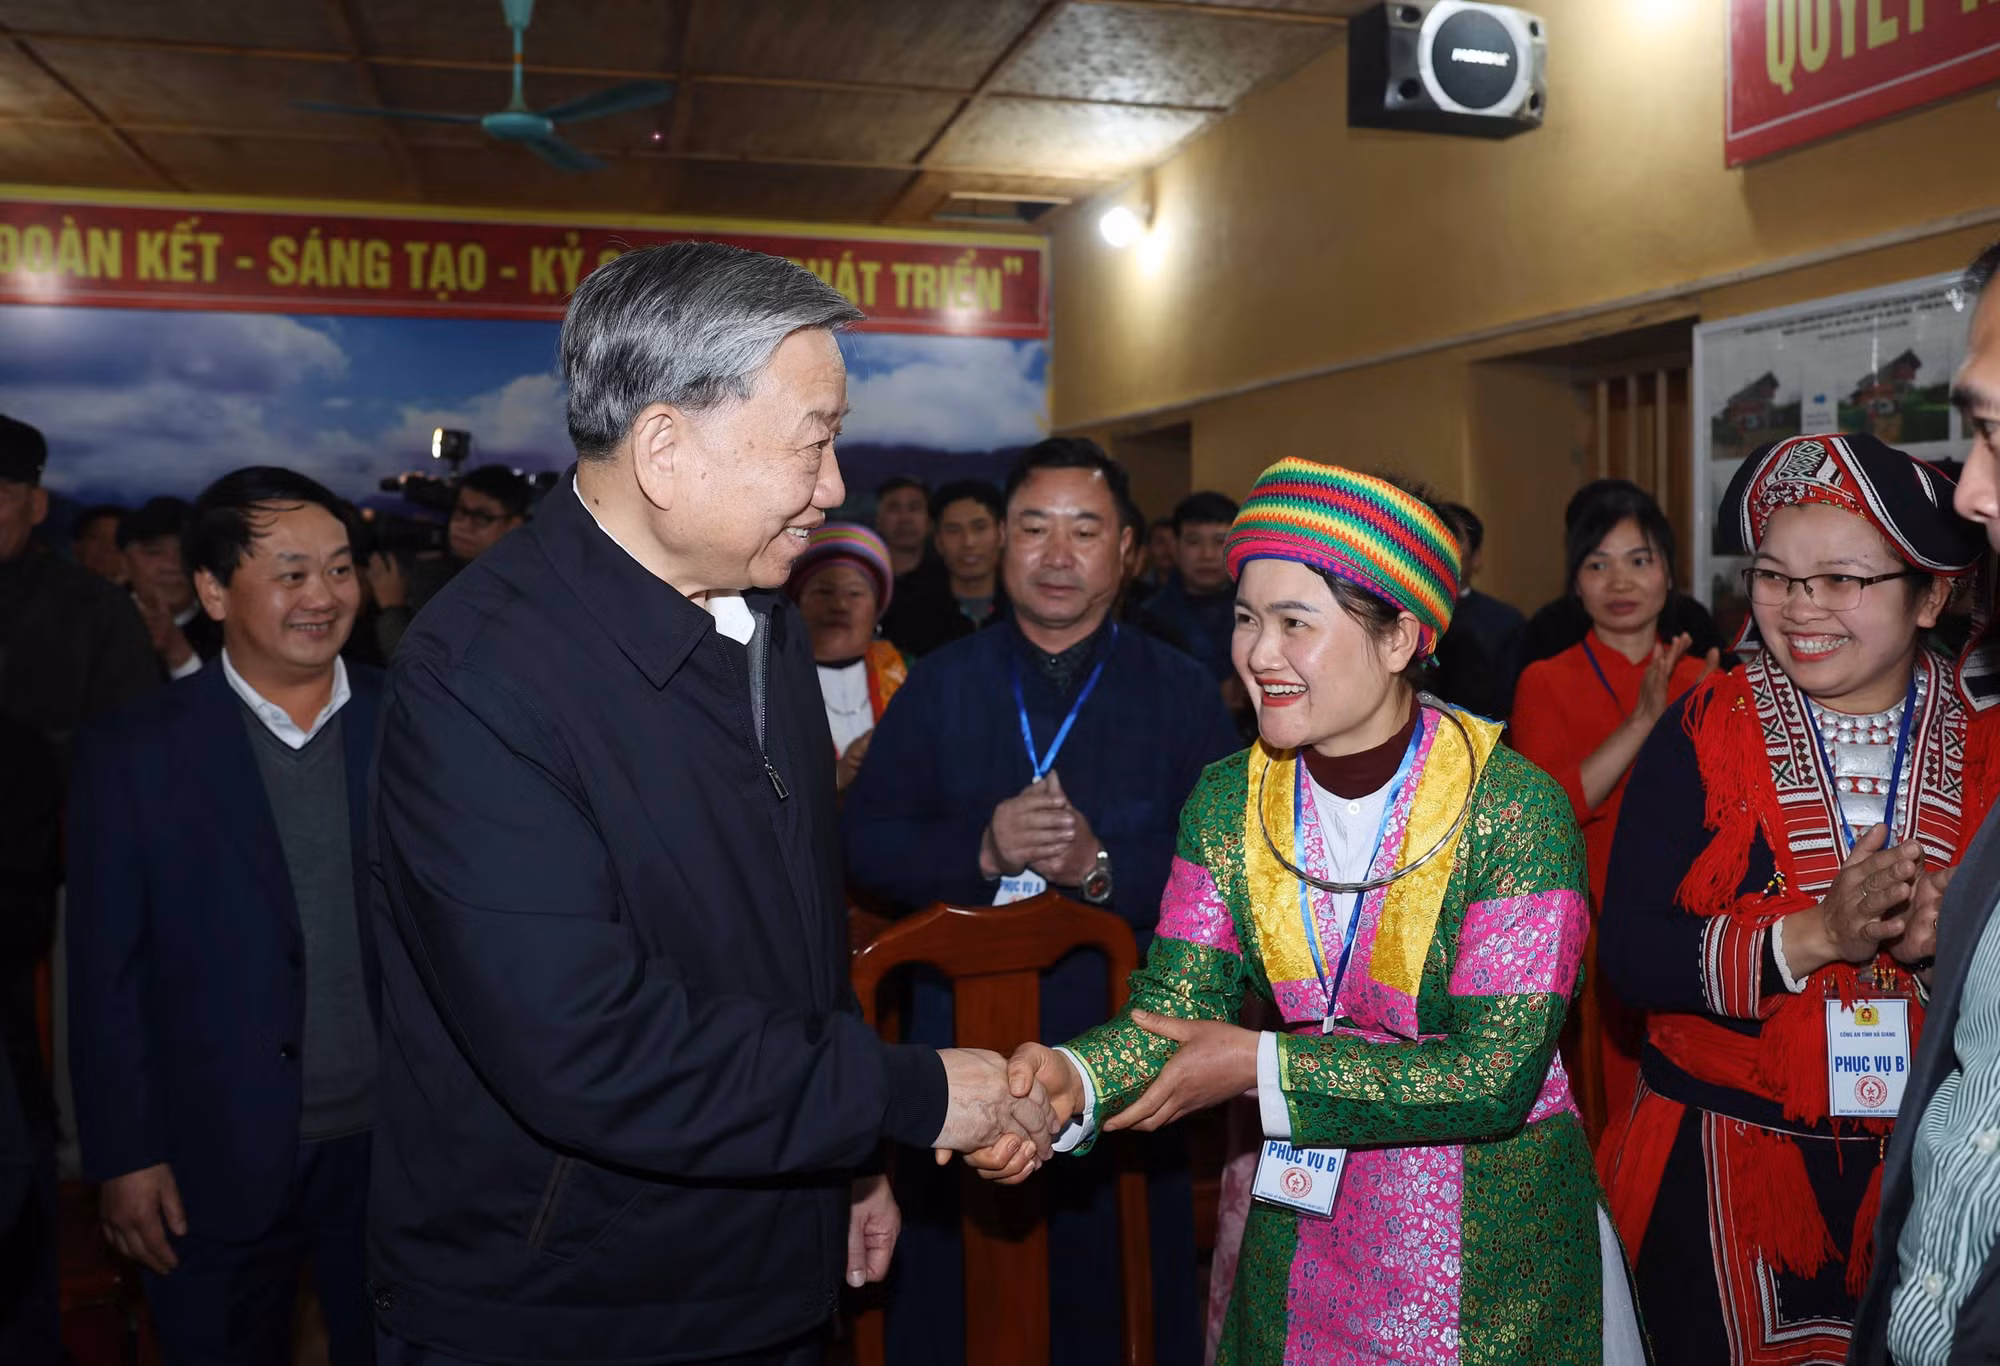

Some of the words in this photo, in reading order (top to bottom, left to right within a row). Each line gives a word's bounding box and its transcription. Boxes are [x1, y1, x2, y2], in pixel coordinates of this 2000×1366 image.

[137, 216, 223, 282] KẾT
[268, 227, 391, 288] SÁNG
[405, 242, 487, 300] TẠO
[1834, 1055, 1870, 1077] PHỤC
[1874, 1055, 1891, 1077] VỤ
[1895, 1055, 1905, 1073] B
[1267, 1141, 1304, 1165] PHỤC
[1306, 1151, 1325, 1173] VỤ
[1326, 1156, 1337, 1173] B
